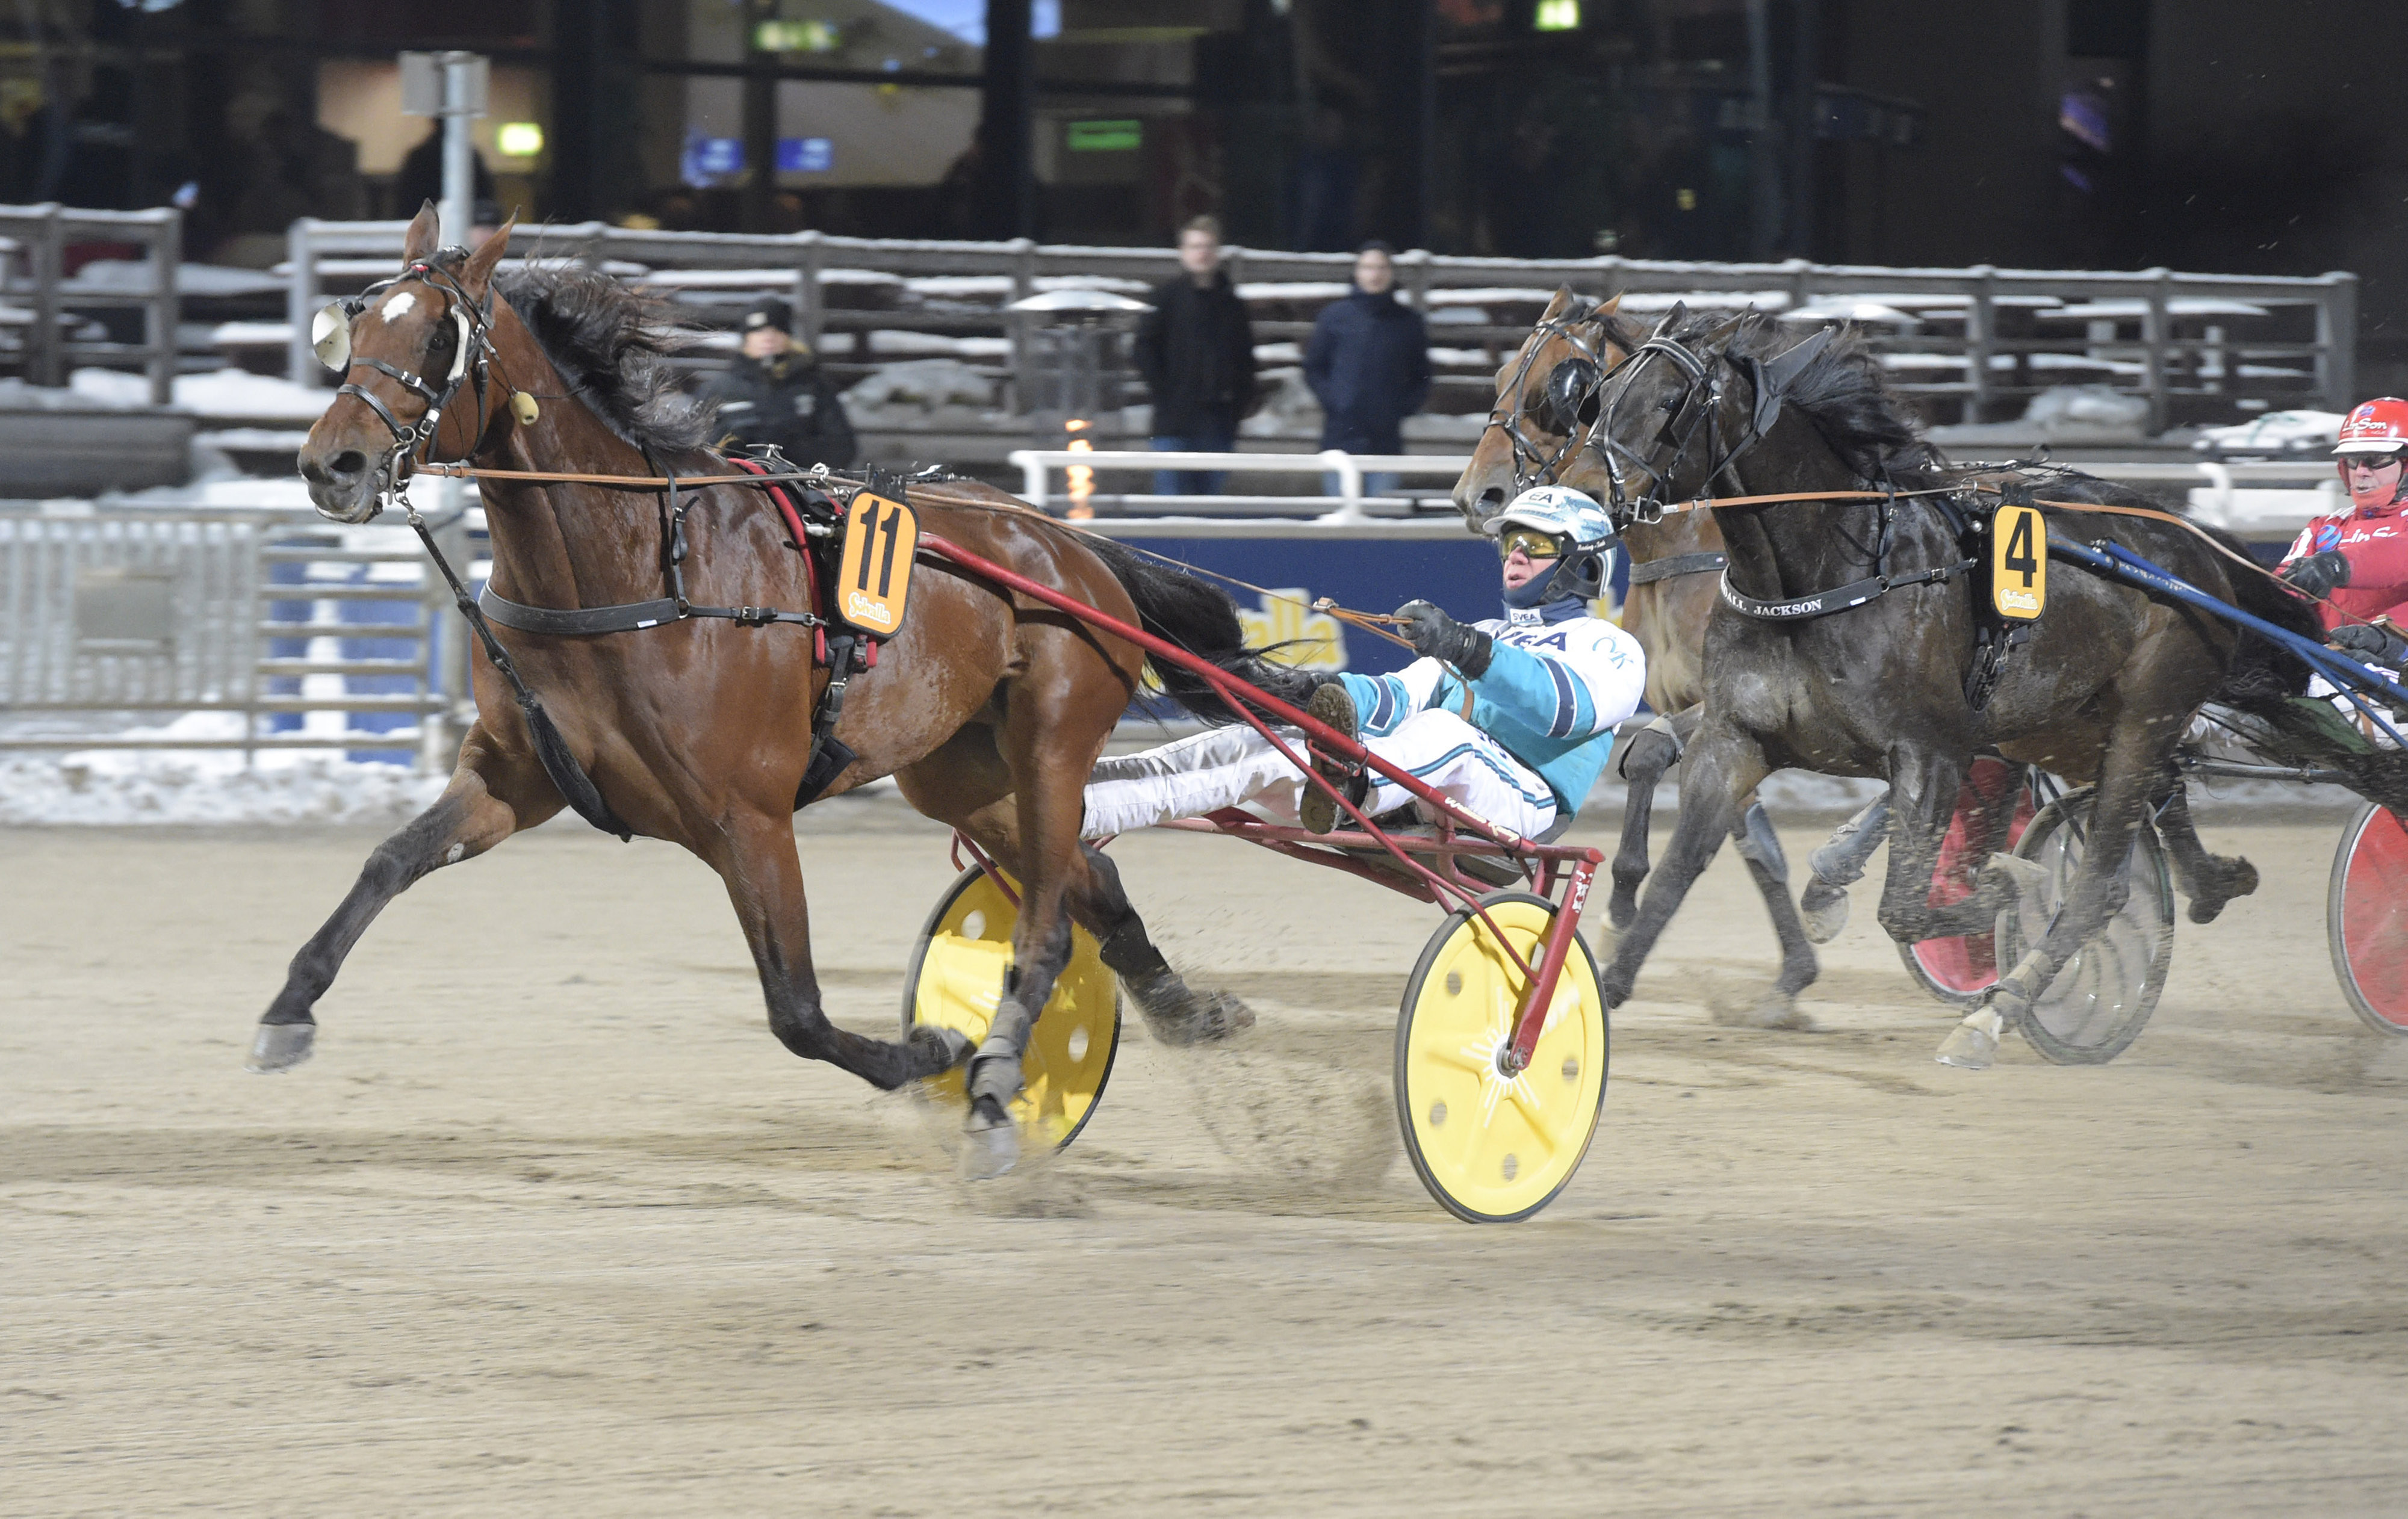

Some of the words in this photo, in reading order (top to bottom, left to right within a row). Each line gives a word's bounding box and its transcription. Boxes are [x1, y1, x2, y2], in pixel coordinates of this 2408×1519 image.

[857, 499, 902, 599] 11
[2005, 511, 2037, 588] 4
[849, 592, 891, 625] Solvalla
[1512, 613, 1538, 621] SVEA
[1753, 599, 1822, 617] JACKSON
